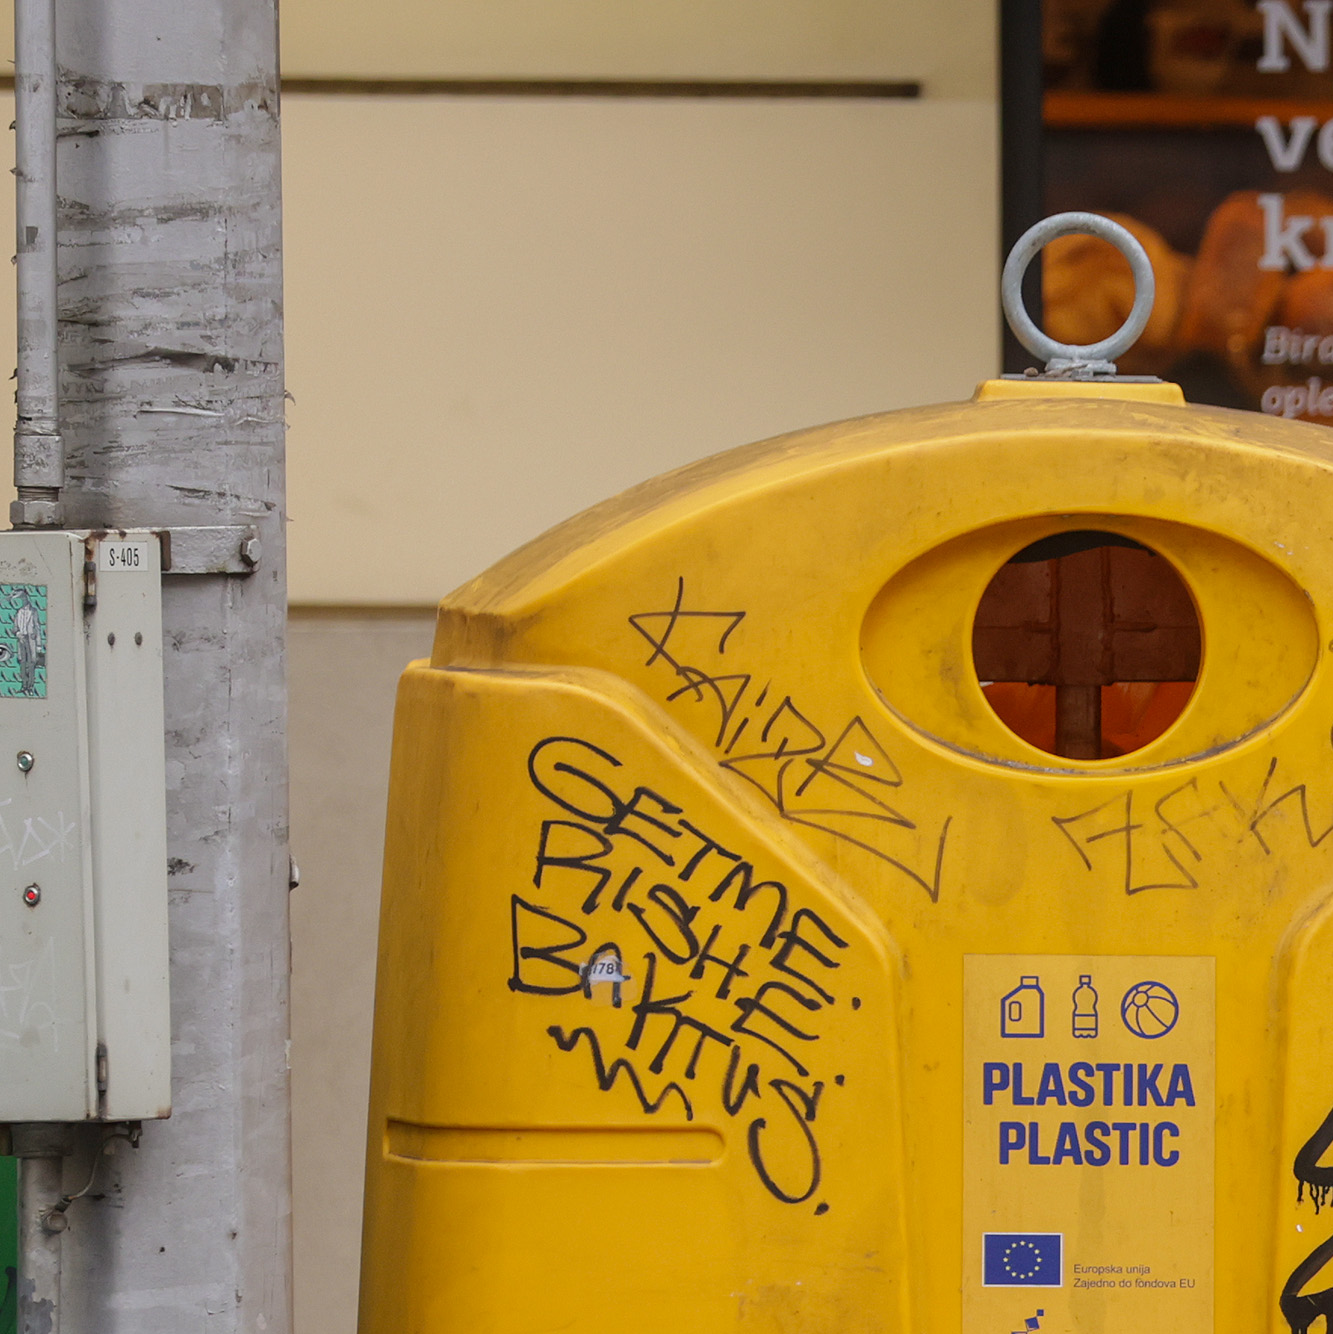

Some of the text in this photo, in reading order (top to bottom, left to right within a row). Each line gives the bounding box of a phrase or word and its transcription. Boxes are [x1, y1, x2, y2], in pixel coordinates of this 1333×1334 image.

[108, 547, 140, 568] S-405
[983, 1062, 1196, 1107] PLASTIKA
[999, 1121, 1180, 1167] PLASTIC
[1073, 1264, 1150, 1275] Europska unija
[1073, 1278, 1196, 1290] Zajedno do fondova EU
